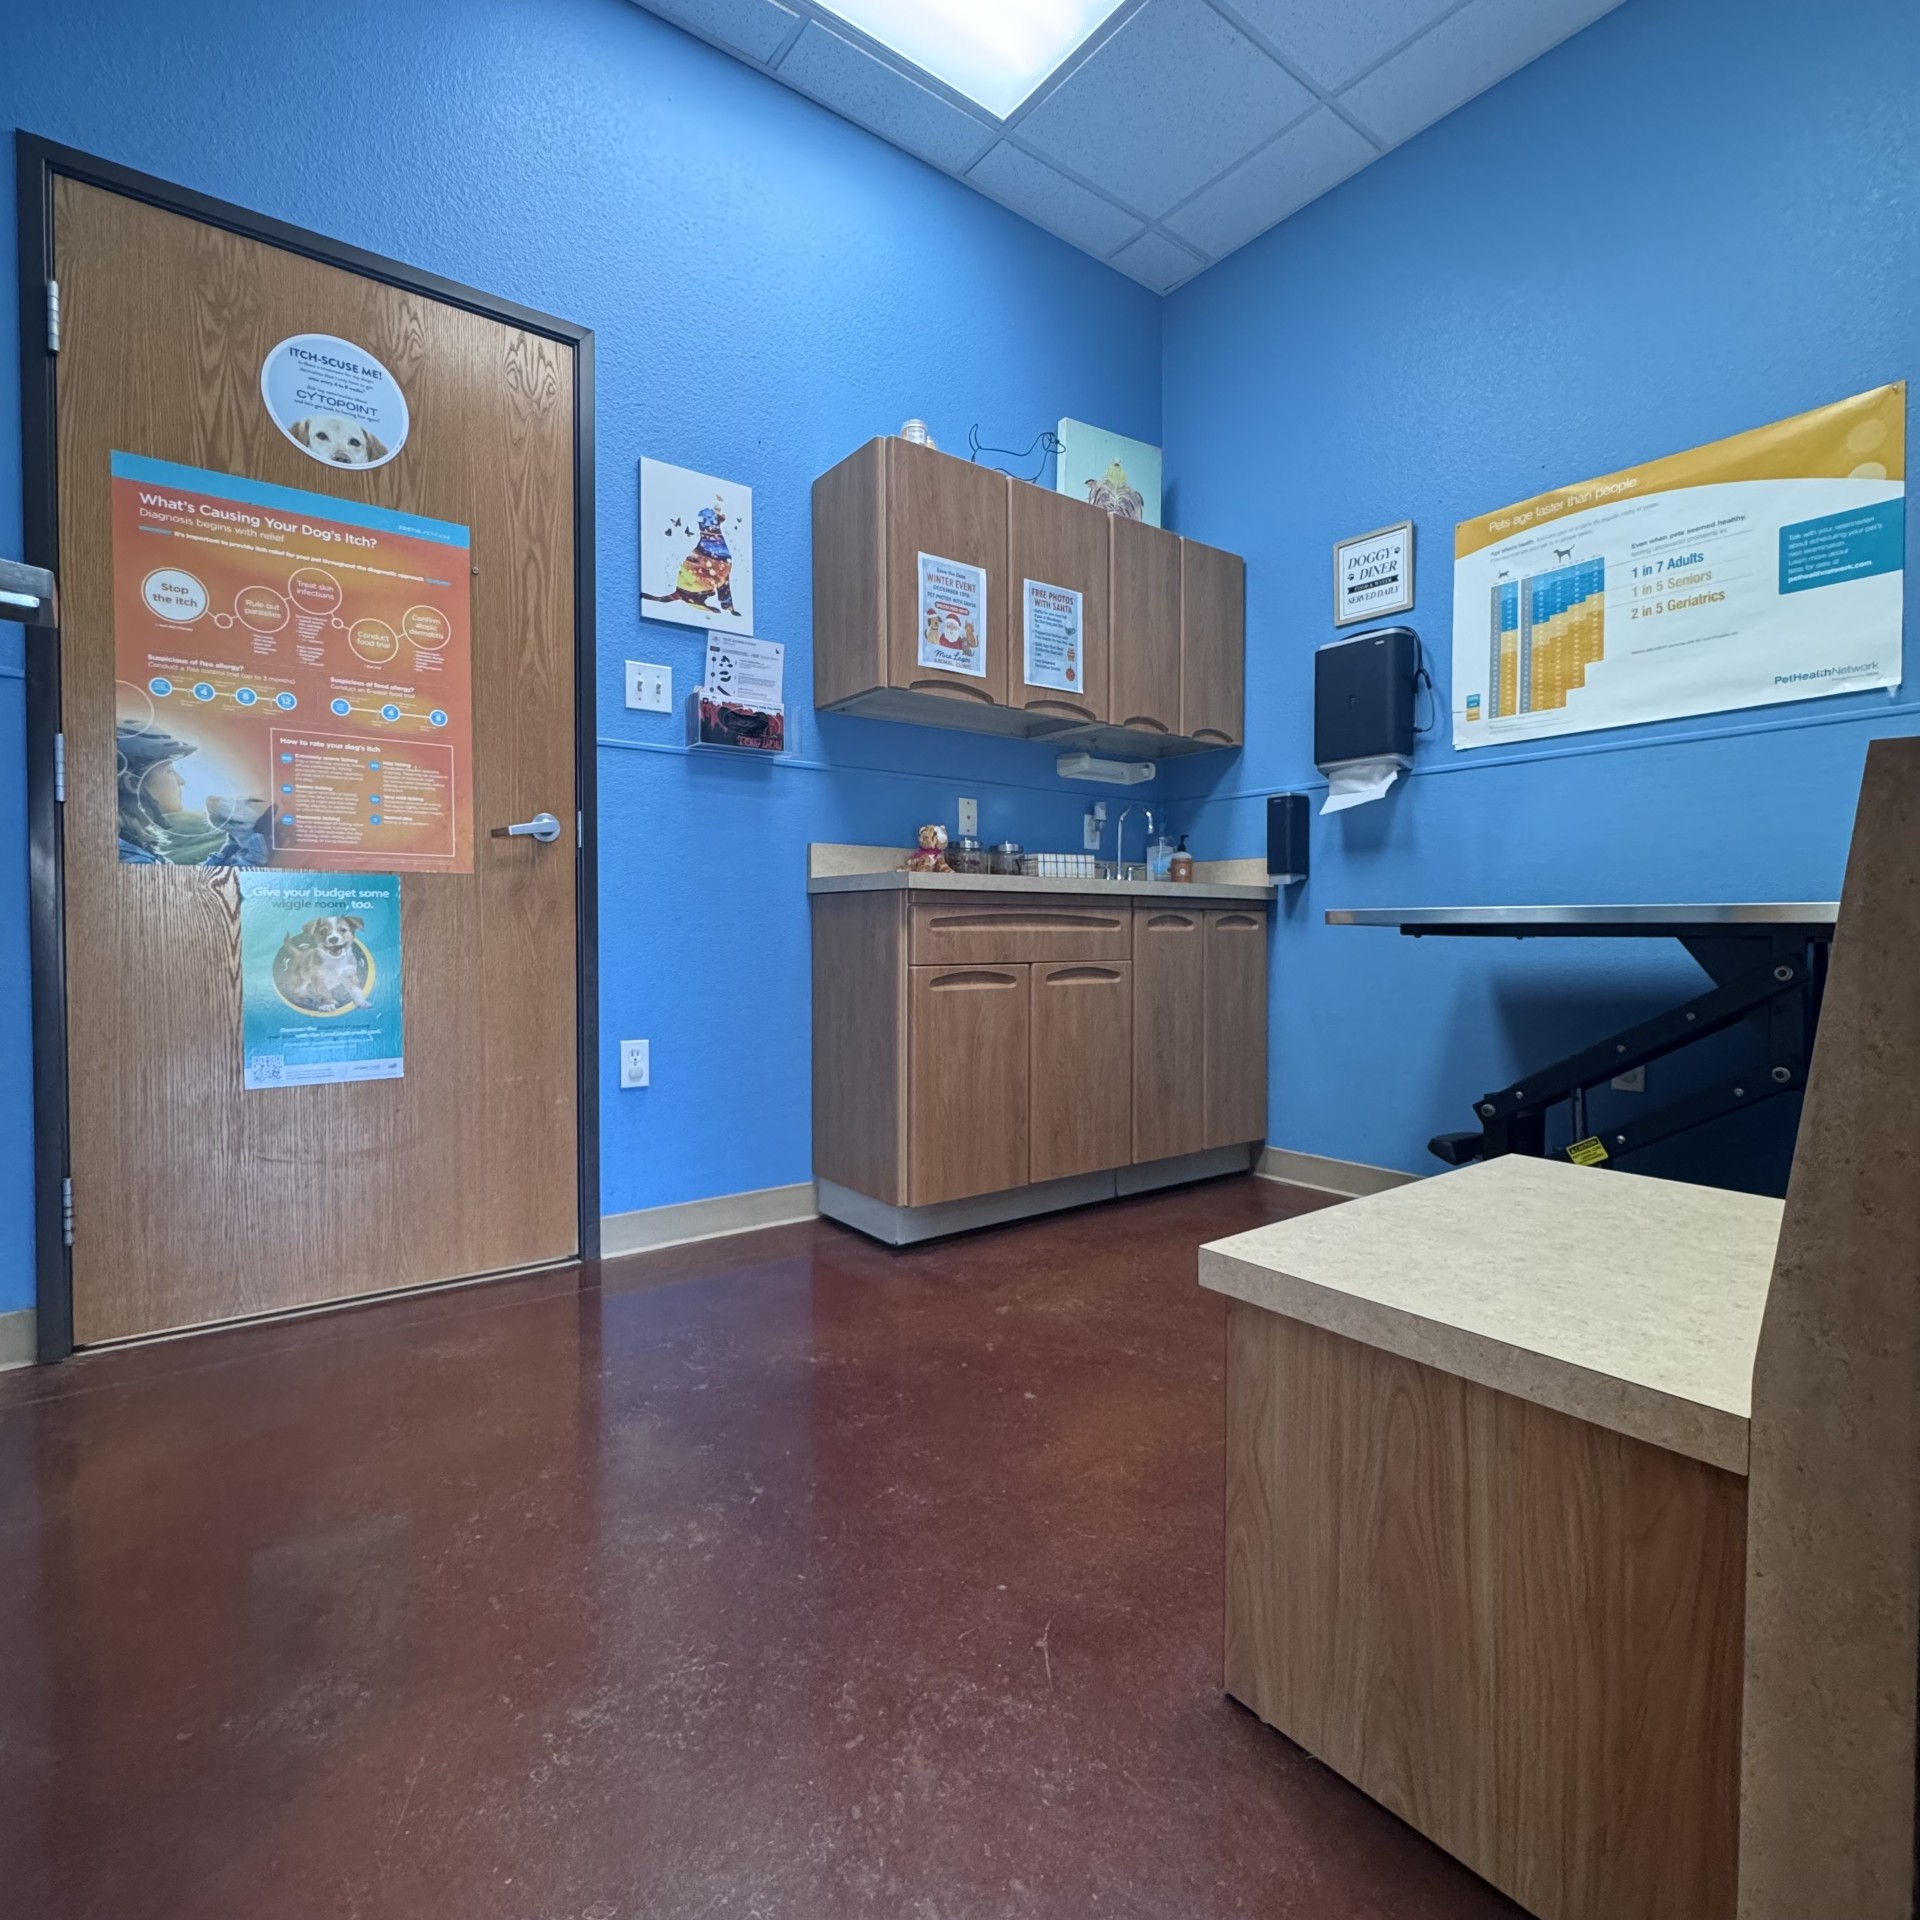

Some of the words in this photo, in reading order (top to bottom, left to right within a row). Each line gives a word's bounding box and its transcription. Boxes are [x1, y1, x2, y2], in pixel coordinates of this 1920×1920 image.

[290, 347, 359, 373] ITCH-SCUSE
[362, 367, 382, 380] ME!
[296, 389, 378, 416] CYTOPOINT
[1489, 518, 1511, 532] Pets
[1512, 511, 1533, 526] age
[1535, 500, 1564, 517] faster
[1567, 491, 1592, 507] than
[1595, 477, 1638, 501] people
[140, 492, 196, 513] What's
[199, 504, 260, 528] Causing
[264, 517, 298, 532] Your
[302, 524, 341, 541] Dog's
[346, 533, 377, 548] Itch?
[140, 508, 194, 526] Diagnosis
[196, 518, 232, 533] begins
[235, 527, 258, 538] with
[260, 531, 285, 542] relief
[1631, 541, 1648, 549] Even
[1649, 535, 1667, 543] when
[1669, 530, 1684, 539] pets
[1687, 522, 1715, 534] seemed
[1717, 515, 1747, 526] healthy.
[1348, 546, 1394, 569] DOGGY
[1631, 568, 1638, 578] 1
[1642, 564, 1652, 576] in
[1656, 561, 1664, 572] 7
[1667, 552, 1704, 570] Adults
[1359, 560, 1398, 580] DINER
[160, 582, 189, 595] Stop
[297, 580, 317, 591] Treat
[318, 584, 334, 592] skin
[927, 572, 953, 587] WINTER
[955, 580, 976, 593] EVENT
[933, 585, 958, 595] DECEMBER
[1631, 586, 1637, 597] 1
[1642, 584, 1652, 595] in
[1656, 580, 1664, 592] 5
[1667, 570, 1712, 589] Seniors
[152, 593, 172, 603] the
[176, 596, 198, 608] itch
[297, 588, 335, 600] infections
[1032, 588, 1046, 598] FREE
[1049, 592, 1073, 605] PHOTOS
[1347, 592, 1377, 605] SERVED
[1377, 584, 1400, 598] DAILY
[245, 599, 264, 609] Rule
[266, 603, 280, 611] out
[1035, 599, 1051, 609] WITH
[1053, 602, 1072, 614] SANTA
[1631, 608, 1638, 620] 2
[1642, 605, 1652, 617] in
[1656, 602, 1663, 614] 5
[1667, 591, 1726, 611] Geriatrics
[244, 608, 282, 619] parasites
[412, 615, 441, 625] Confirm
[415, 623, 438, 632] atopic
[357, 631, 390, 642] Conduct
[357, 637, 376, 647] food
[147, 654, 188, 665] Suspicious
[215, 662, 245, 672] allergy?
[148, 661, 179, 671] Conduct
[1774, 661, 1880, 685] PetHealthNetwork
[281, 697, 291, 705] 12
[252, 887, 280, 897] Give
[283, 889, 311, 899] your
[314, 888, 357, 899] budget
[359, 890, 389, 898] some
[271, 900, 312, 910] wiggle
[315, 901, 349, 910] room,
[352, 901, 374, 909] too.
